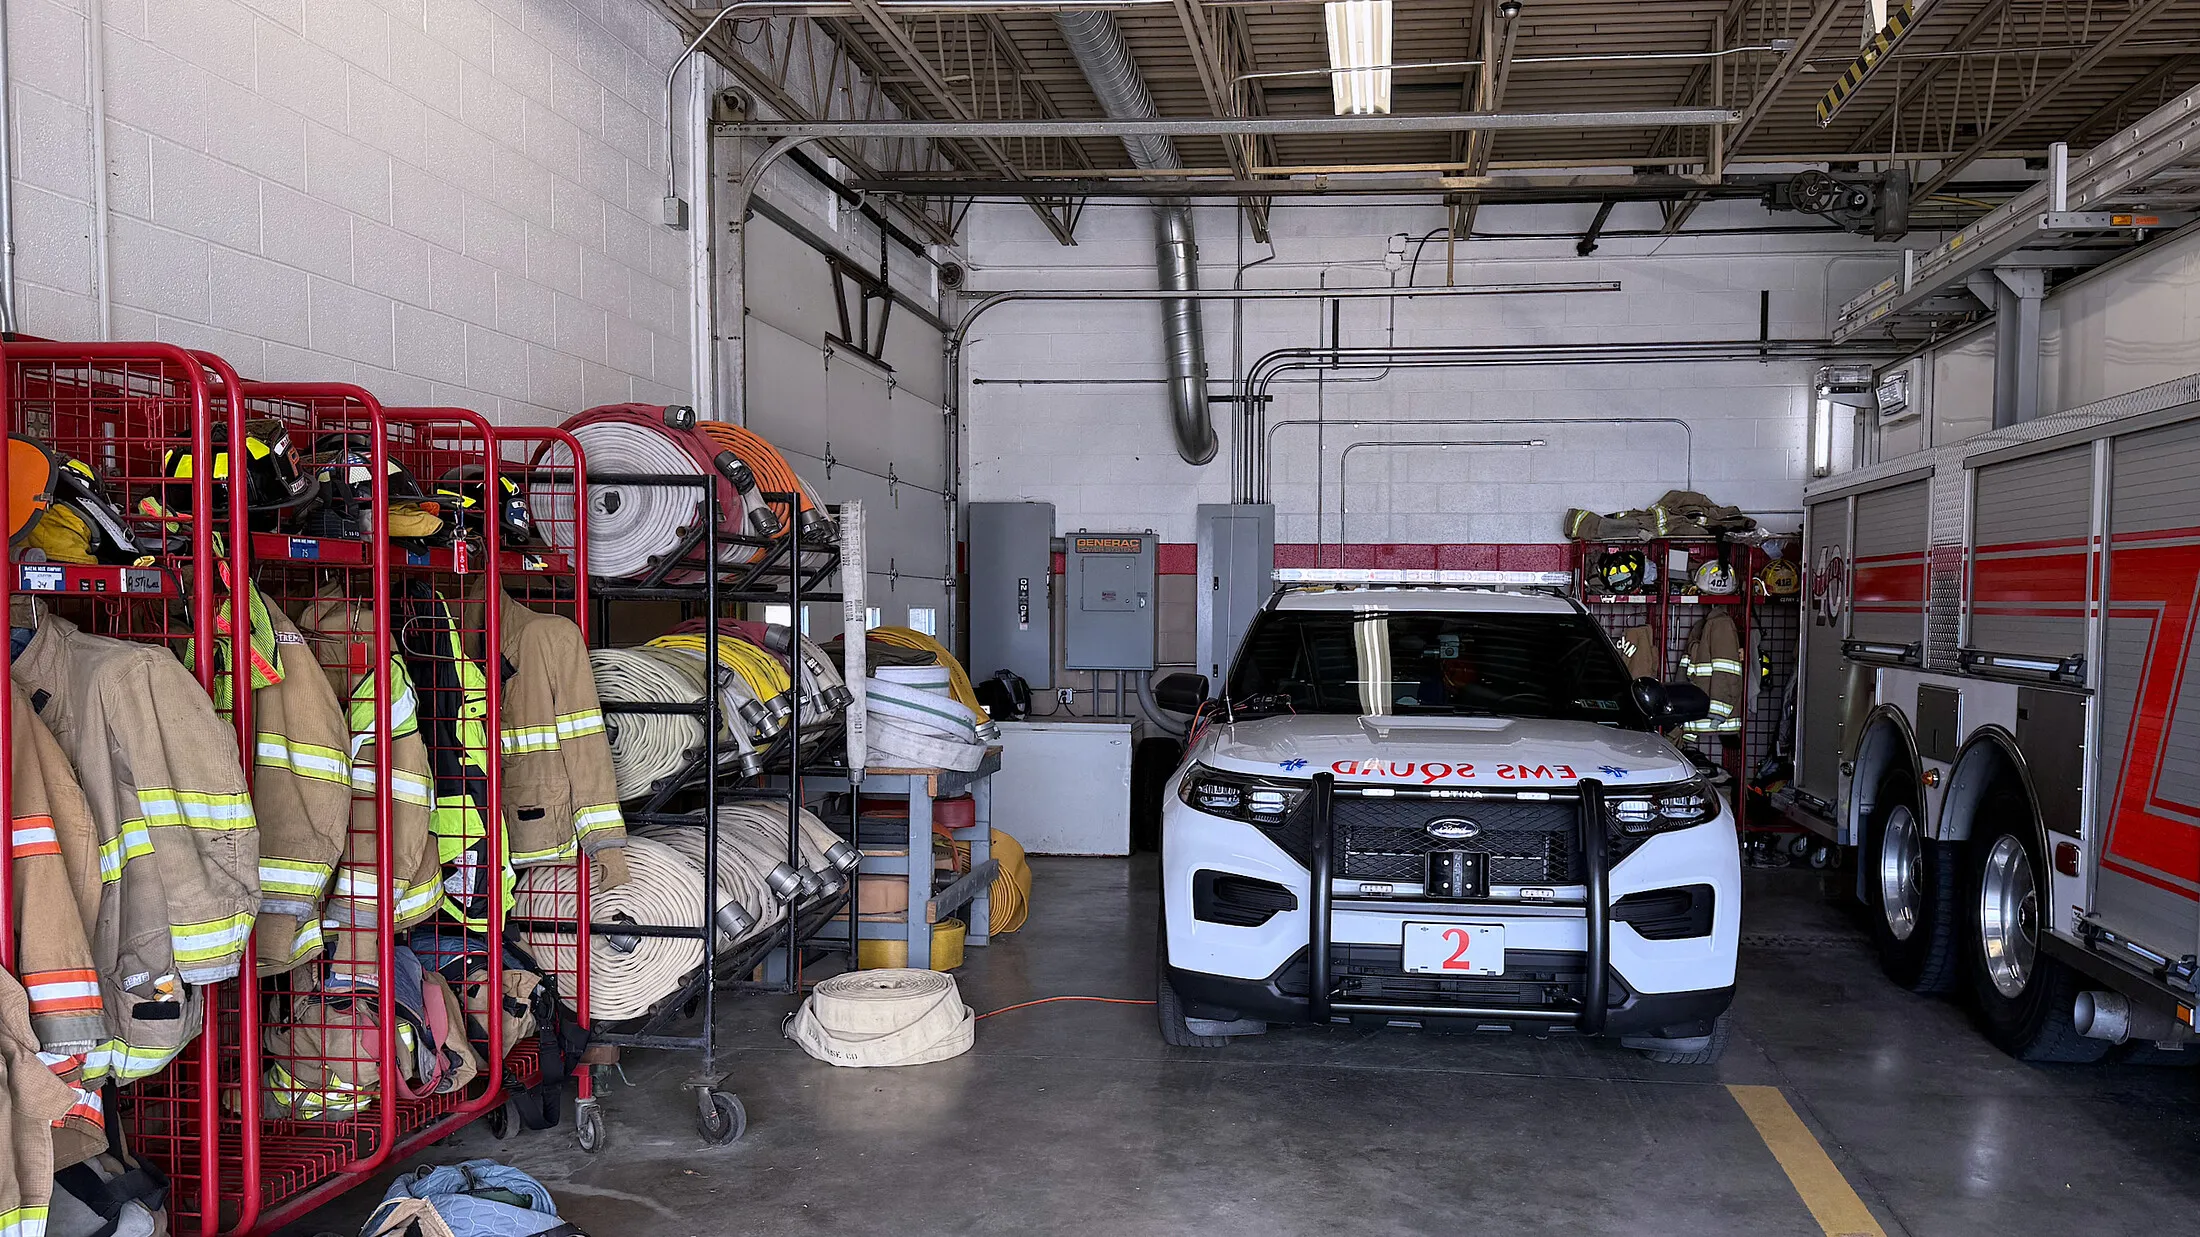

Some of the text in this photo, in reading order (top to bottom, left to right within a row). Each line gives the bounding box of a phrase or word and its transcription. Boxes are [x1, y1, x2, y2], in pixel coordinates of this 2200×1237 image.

[1077, 539, 1139, 547] GENERAC
[1020, 579, 1028, 591] ON
[1710, 578, 1728, 587] 401
[1430, 790, 1483, 798] SETINA
[1435, 821, 1473, 834] Ford
[1442, 927, 1470, 970] 2
